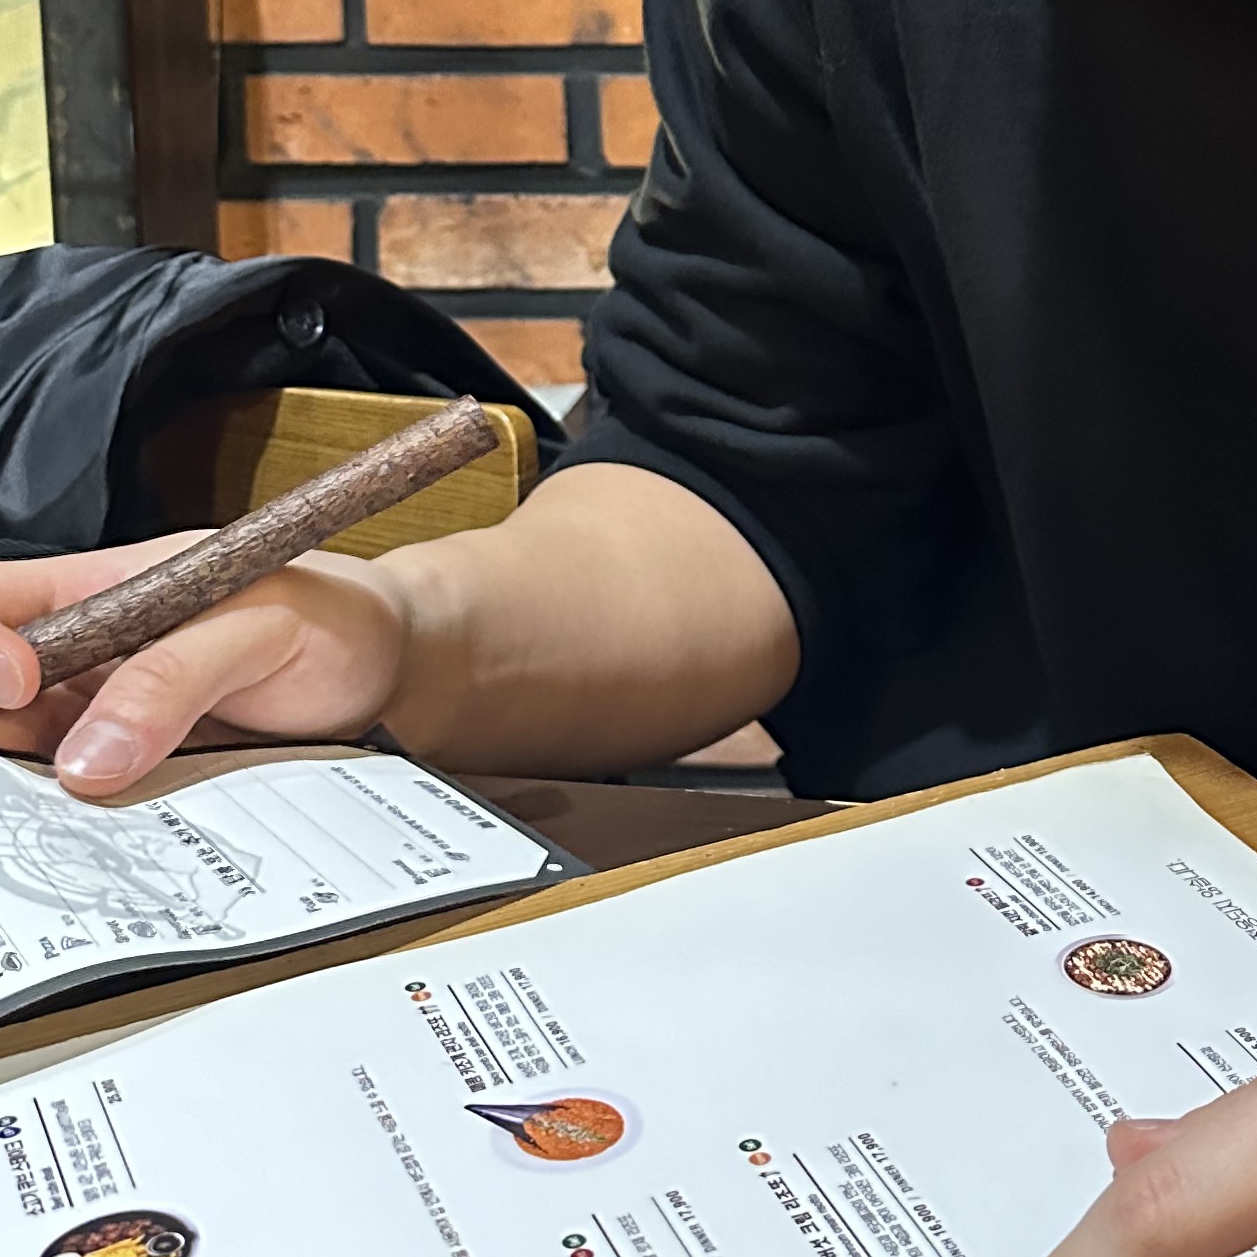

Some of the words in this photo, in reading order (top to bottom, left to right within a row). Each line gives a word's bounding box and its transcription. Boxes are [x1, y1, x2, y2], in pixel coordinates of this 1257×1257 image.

[858, 1133, 889, 1163] 17,900
[768, 1177, 800, 1210] 리조또
[885, 1165, 912, 1193] DINNER
[665, 1189, 696, 1222] 17,900
[791, 1212, 820, 1234] 크림
[913, 1205, 946, 1237] 16,900
[688, 1223, 717, 1253] DINNER
